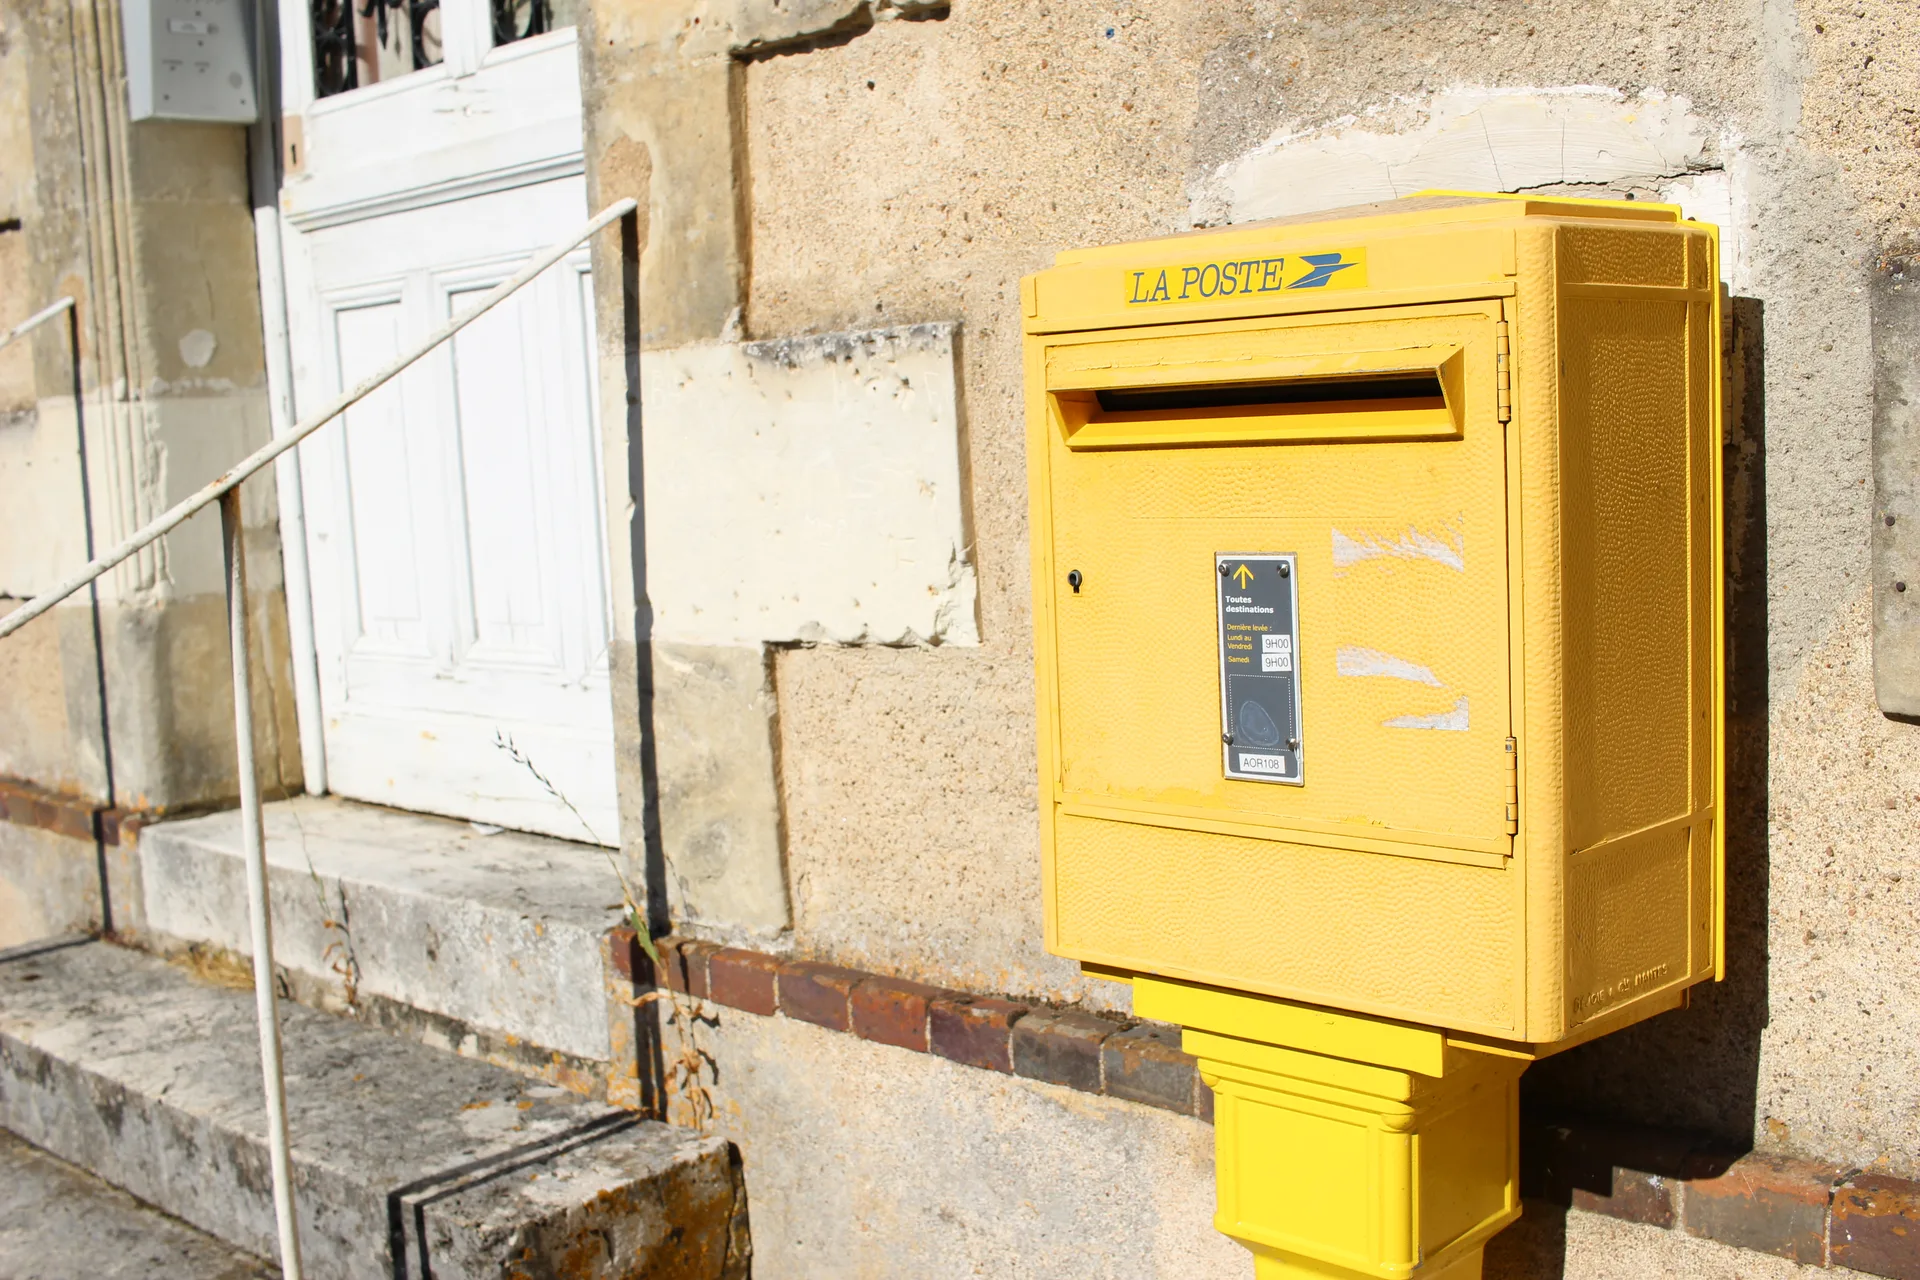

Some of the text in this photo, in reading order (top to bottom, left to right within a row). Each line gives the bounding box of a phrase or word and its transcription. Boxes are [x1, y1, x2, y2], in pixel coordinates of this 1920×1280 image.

[1129, 257, 1285, 303] LA POSTE
[1225, 595, 1252, 604] Toutes
[1225, 605, 1274, 614] destinations
[1226, 623, 1251, 631] Dernière
[1265, 638, 1289, 649] 9H00
[1227, 655, 1250, 663] Samedi
[1265, 657, 1289, 668] 9H00
[1243, 757, 1280, 770] AOR108
